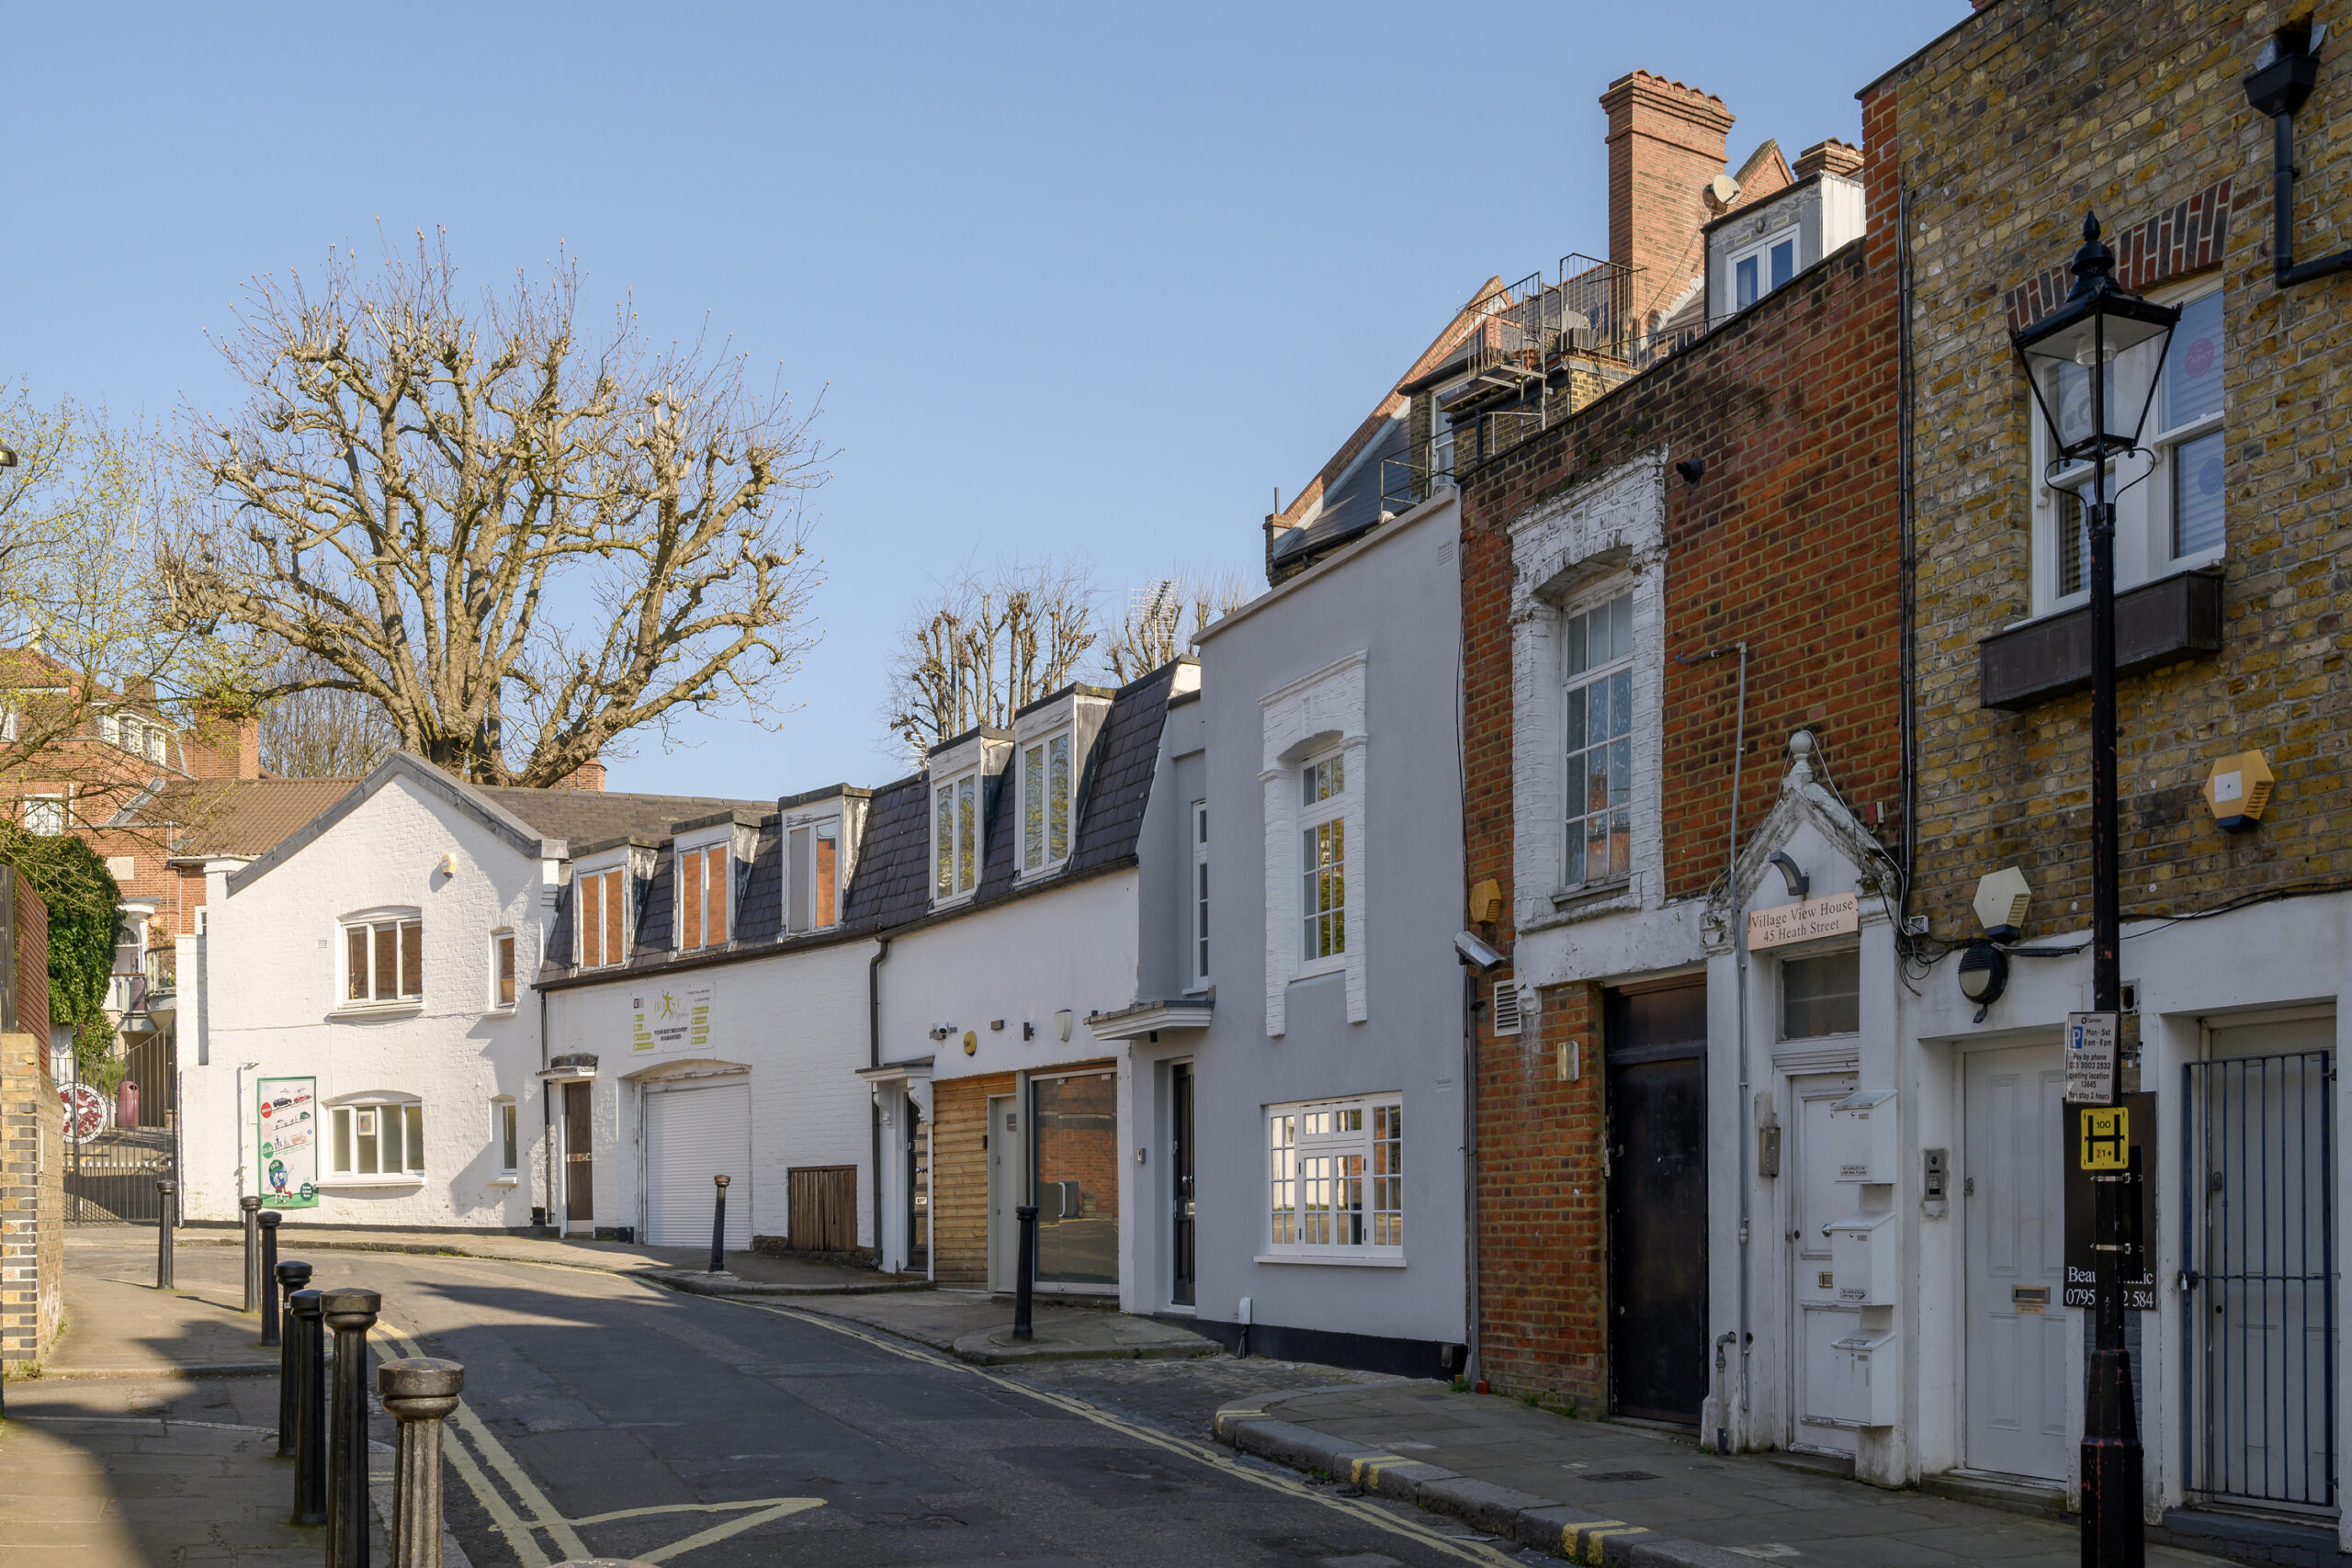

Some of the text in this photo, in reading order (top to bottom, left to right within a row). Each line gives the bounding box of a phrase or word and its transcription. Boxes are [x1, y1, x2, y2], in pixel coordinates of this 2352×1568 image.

[1751, 900, 1853, 929] Village View House
[1763, 919, 1839, 942] 45 Heath Street
[2073, 1053, 2082, 1061] Pay
[2069, 1072, 2109, 1080] quoting location
[2079, 1091, 2089, 1100] stay
[2096, 1121, 2111, 1129] 100
[2066, 1288, 2096, 1305] 0795
[2132, 1291, 2154, 1307] 584
